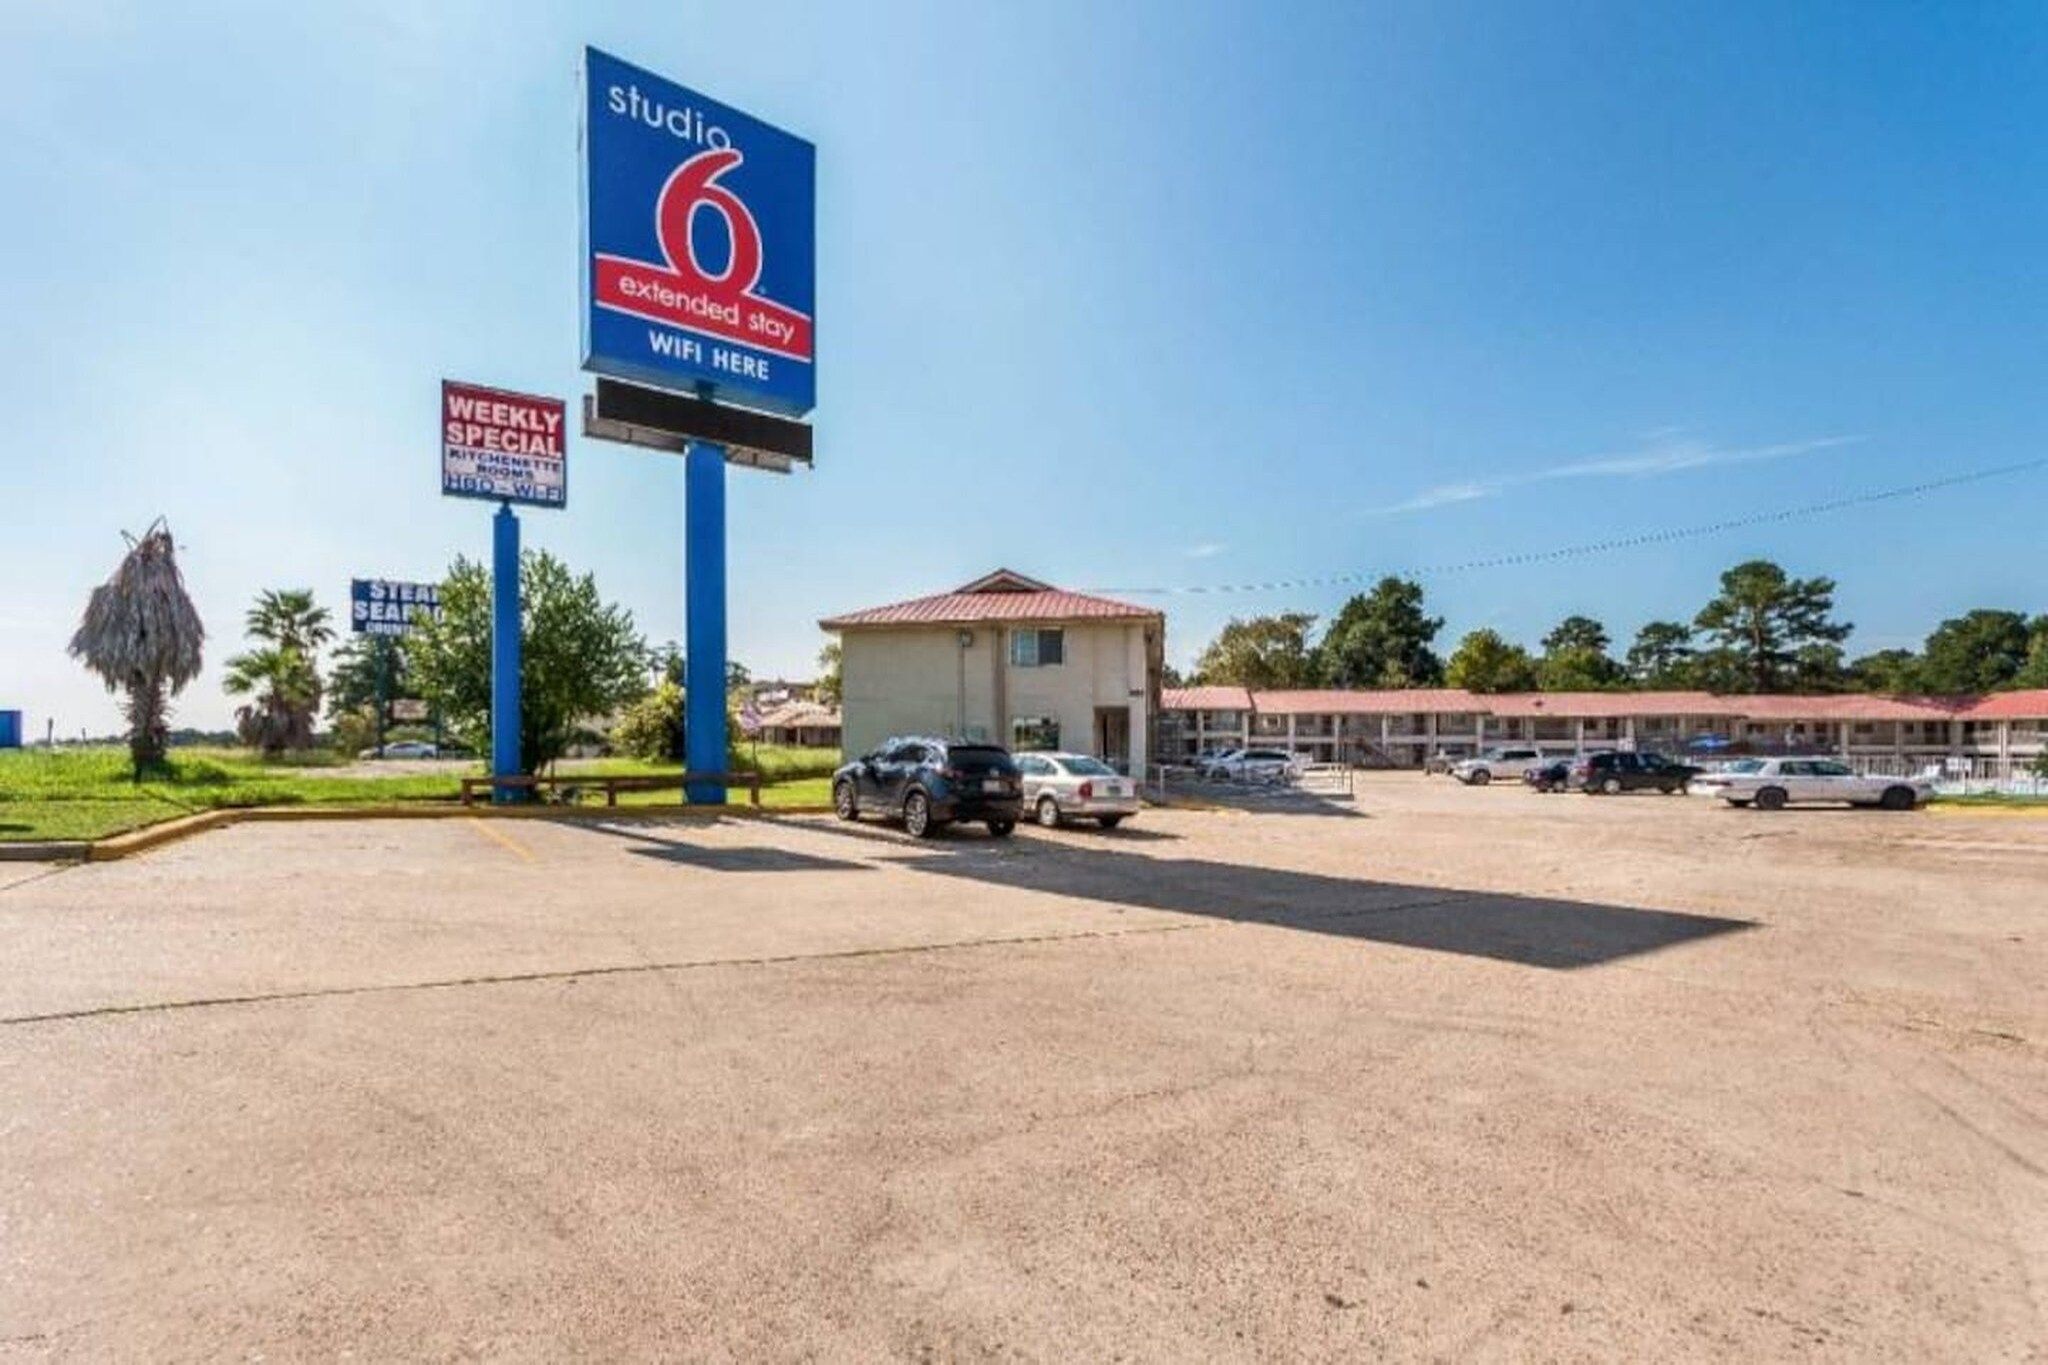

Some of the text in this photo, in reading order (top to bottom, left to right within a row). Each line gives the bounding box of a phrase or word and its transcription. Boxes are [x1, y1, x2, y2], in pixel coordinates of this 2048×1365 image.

[608, 84, 731, 151] studio
[655, 148, 763, 296] 6
[619, 276, 795, 345] extended stay
[649, 330, 770, 381] WIFI HERE
[446, 421, 560, 457] SPECIAL
[447, 394, 561, 433] WEEKLY
